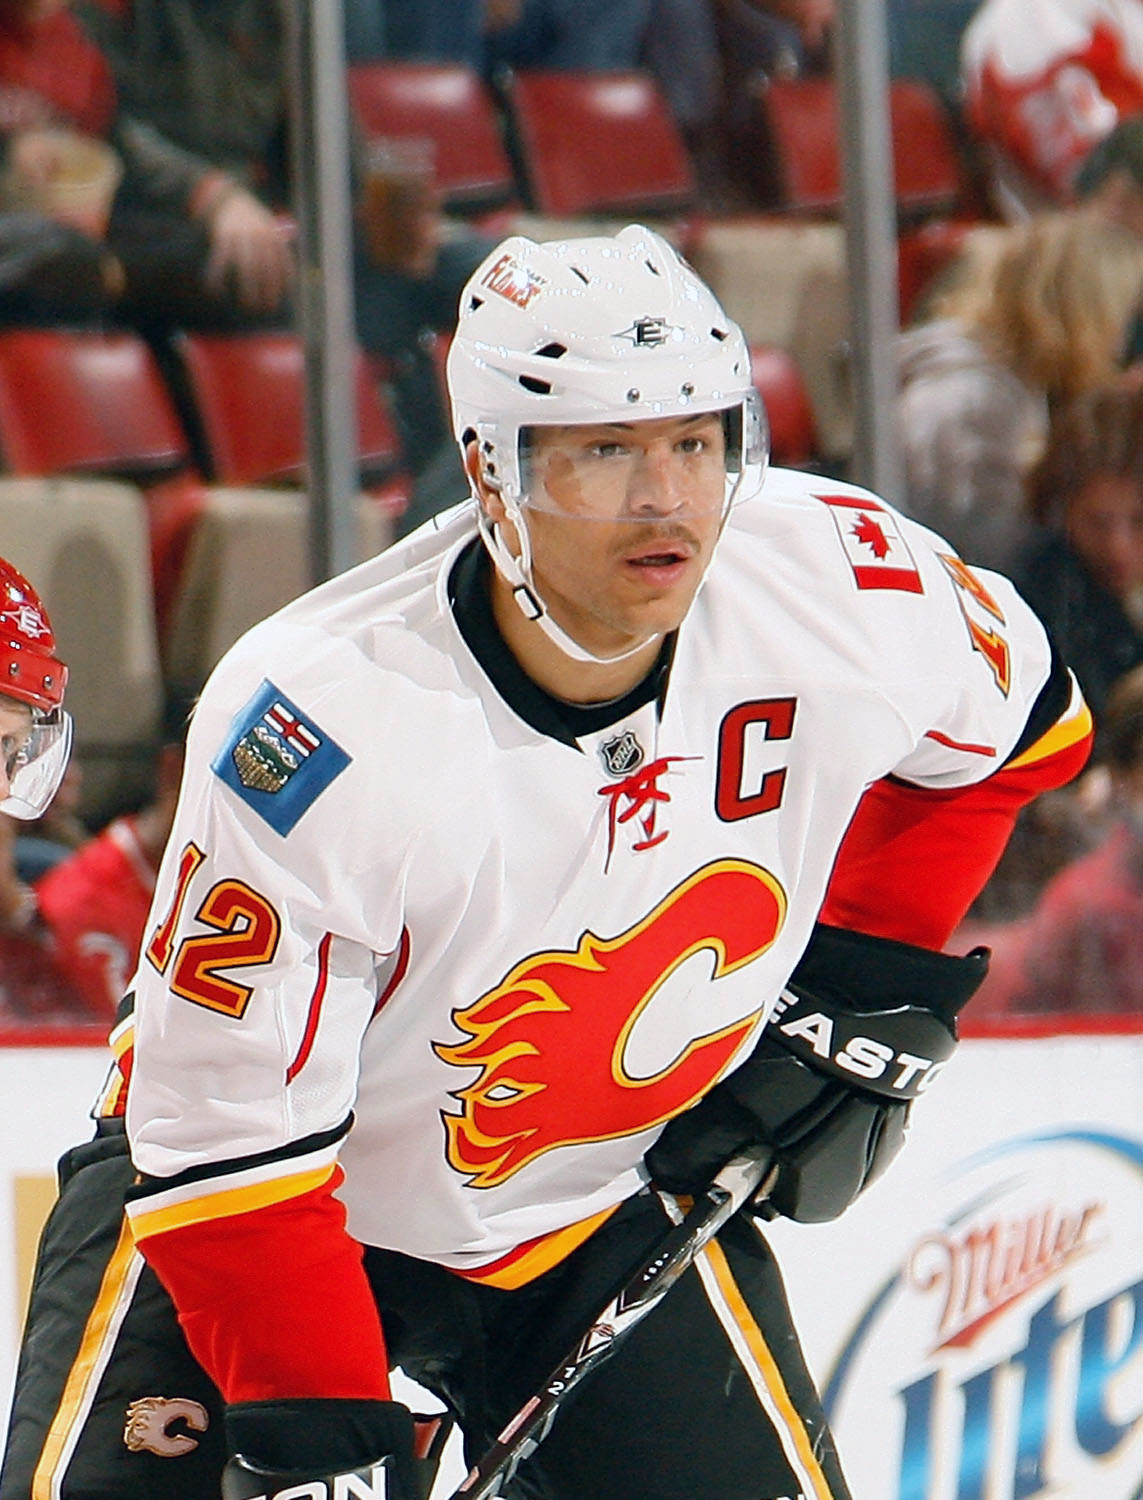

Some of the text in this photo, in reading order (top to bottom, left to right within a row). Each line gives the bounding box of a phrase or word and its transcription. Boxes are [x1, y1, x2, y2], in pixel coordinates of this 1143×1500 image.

[714, 697, 798, 823] C
[146, 842, 282, 1021] 12
[906, 1198, 1110, 1345] Miller
